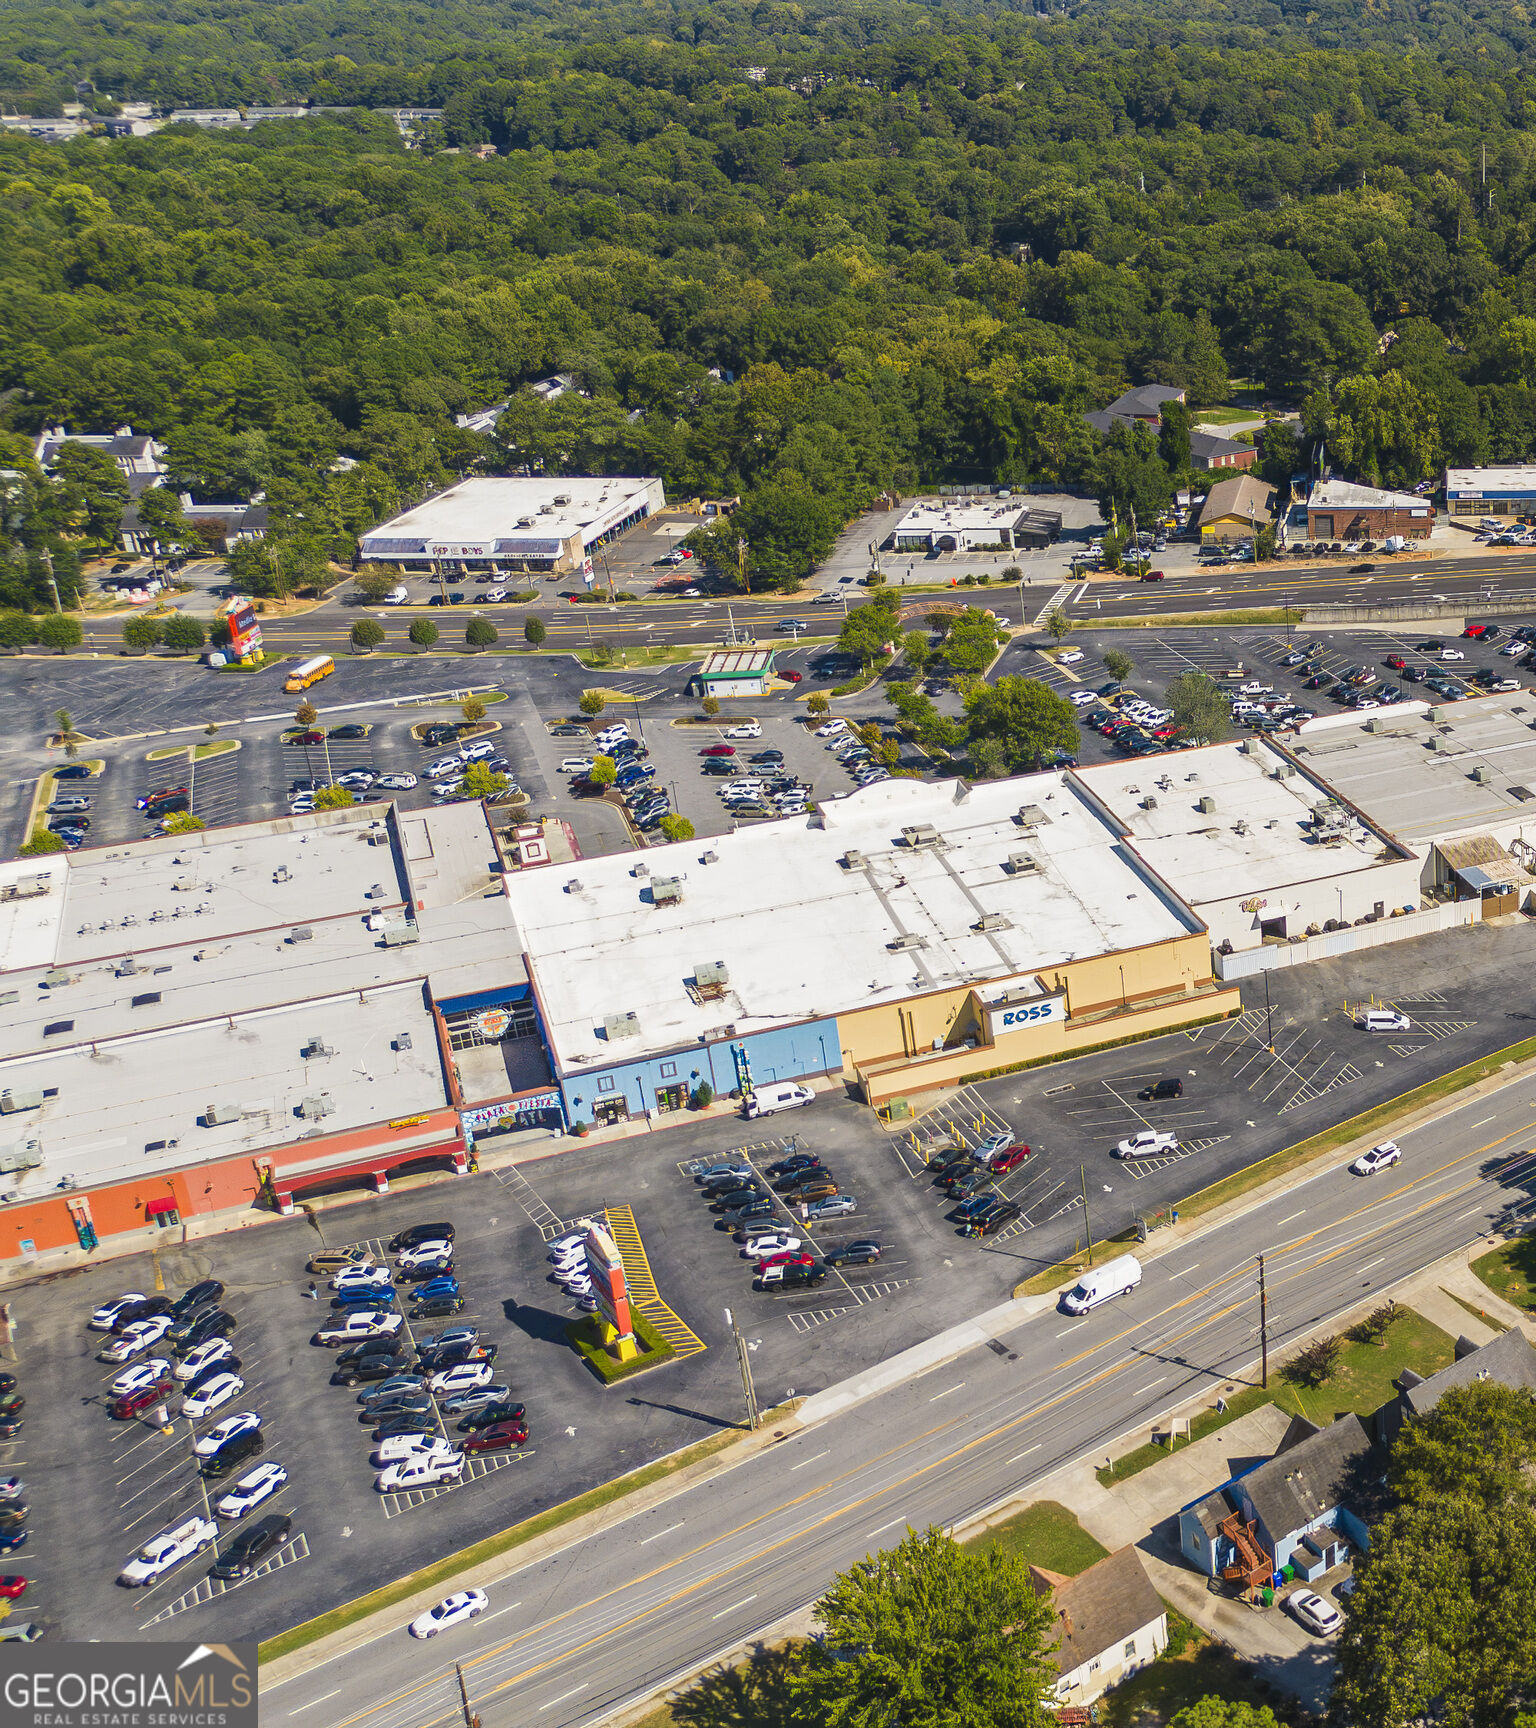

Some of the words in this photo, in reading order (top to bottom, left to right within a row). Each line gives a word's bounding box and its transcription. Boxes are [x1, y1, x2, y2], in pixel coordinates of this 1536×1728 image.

[1003, 1003, 1052, 1026] ROSS
[476, 1106, 505, 1121] PLAZA
[519, 1098, 551, 1110] FIESTA
